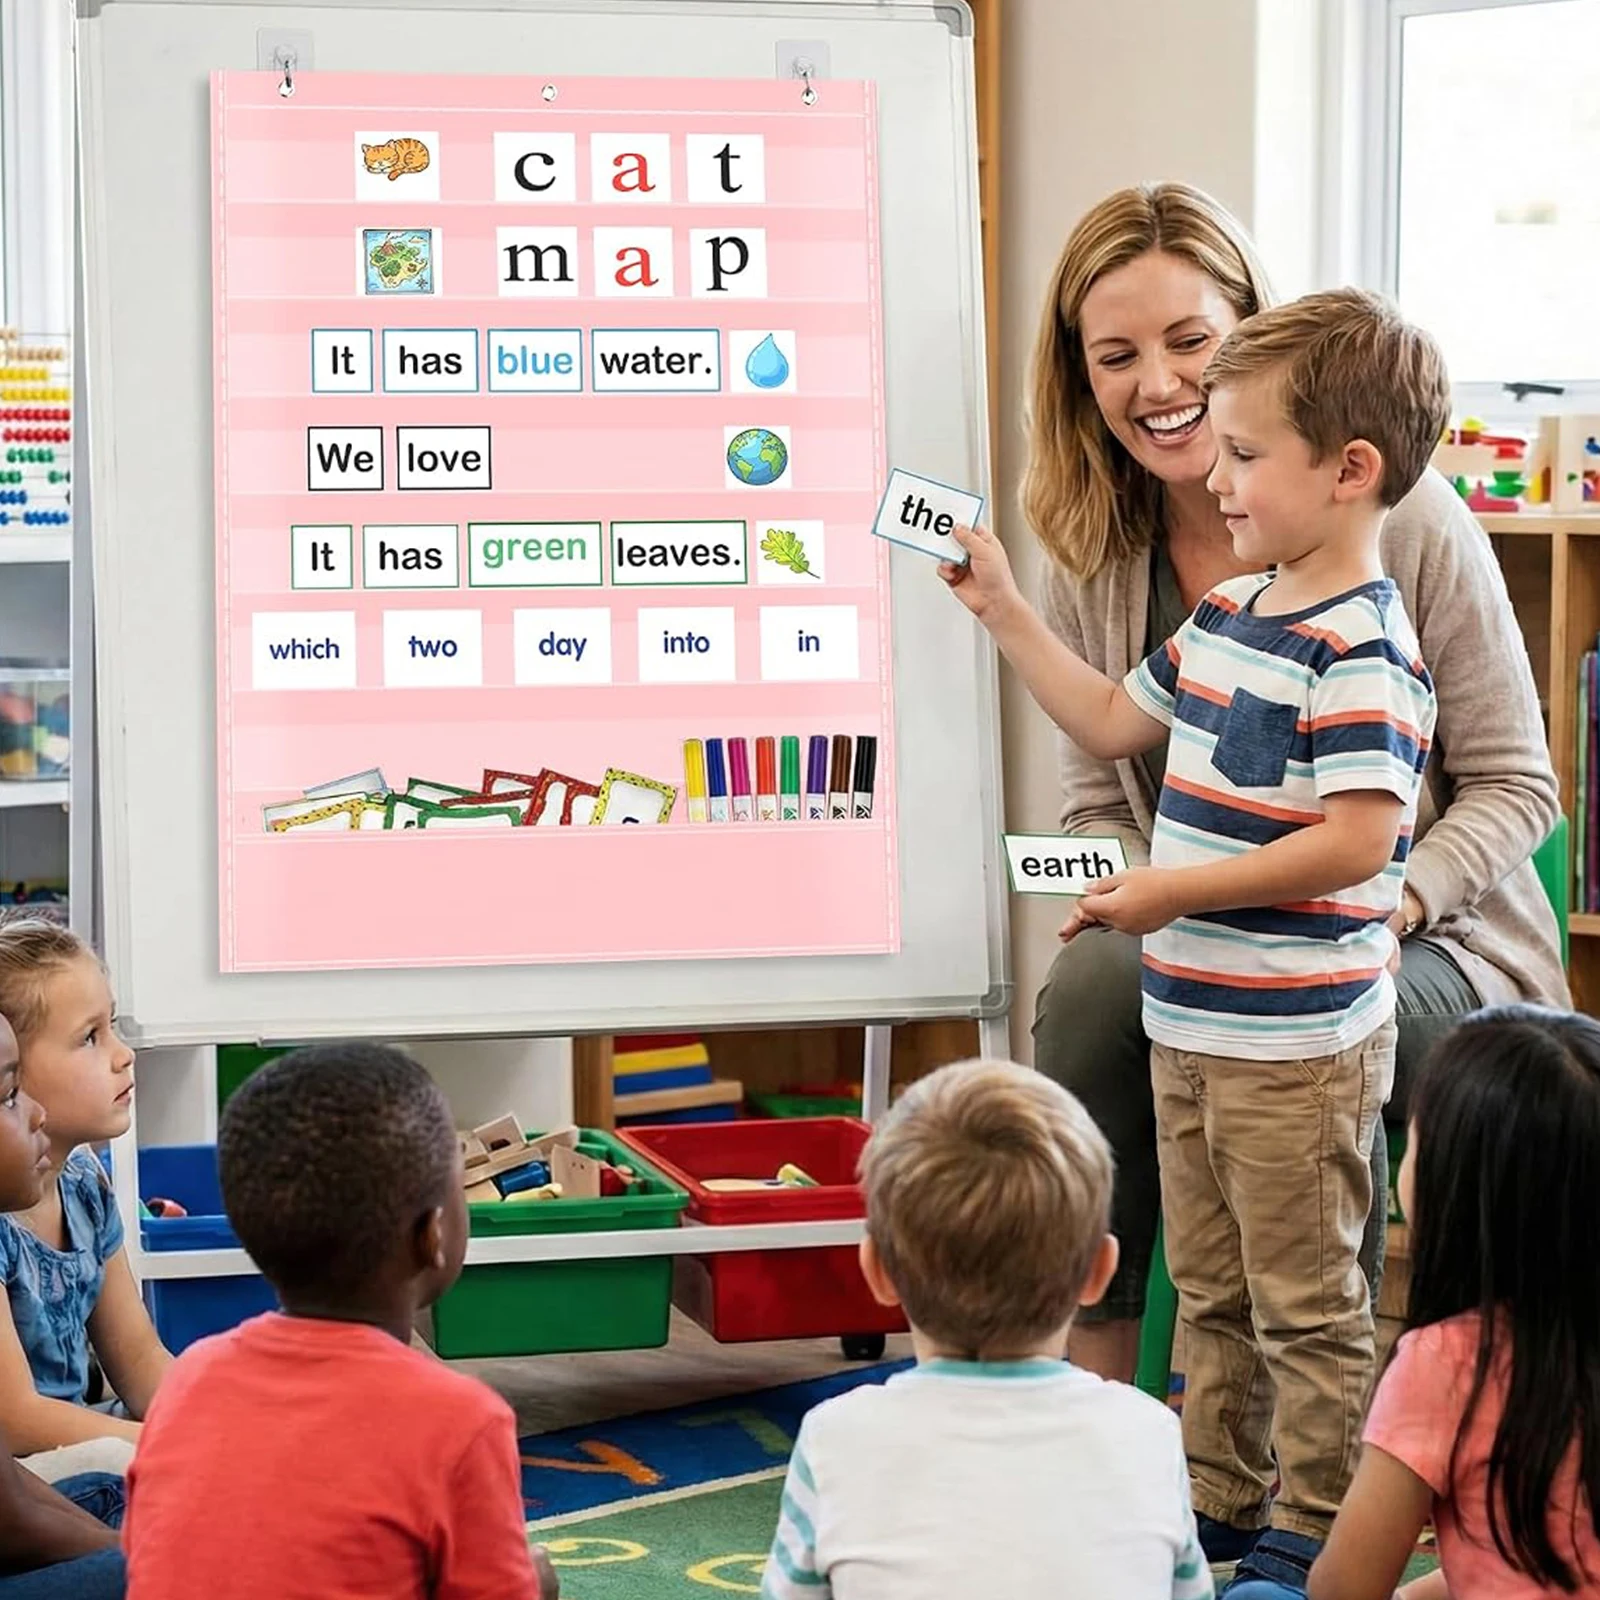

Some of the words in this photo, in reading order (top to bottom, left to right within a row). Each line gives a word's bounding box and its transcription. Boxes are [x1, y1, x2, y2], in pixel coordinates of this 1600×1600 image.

[331, 346, 356, 375] It
[400, 344, 463, 375] has
[498, 345, 573, 375] blue
[600, 345, 712, 375] water.
[316, 442, 374, 473] We
[407, 442, 481, 473] love
[900, 494, 954, 536] the
[311, 541, 336, 572] It
[379, 540, 443, 571] has
[483, 538, 586, 568] green
[617, 537, 741, 568] leaves.
[269, 637, 340, 660] which
[408, 635, 458, 658] two
[538, 631, 588, 662] day
[663, 630, 710, 654] into
[798, 629, 820, 653] in
[1021, 851, 1114, 878] earth
